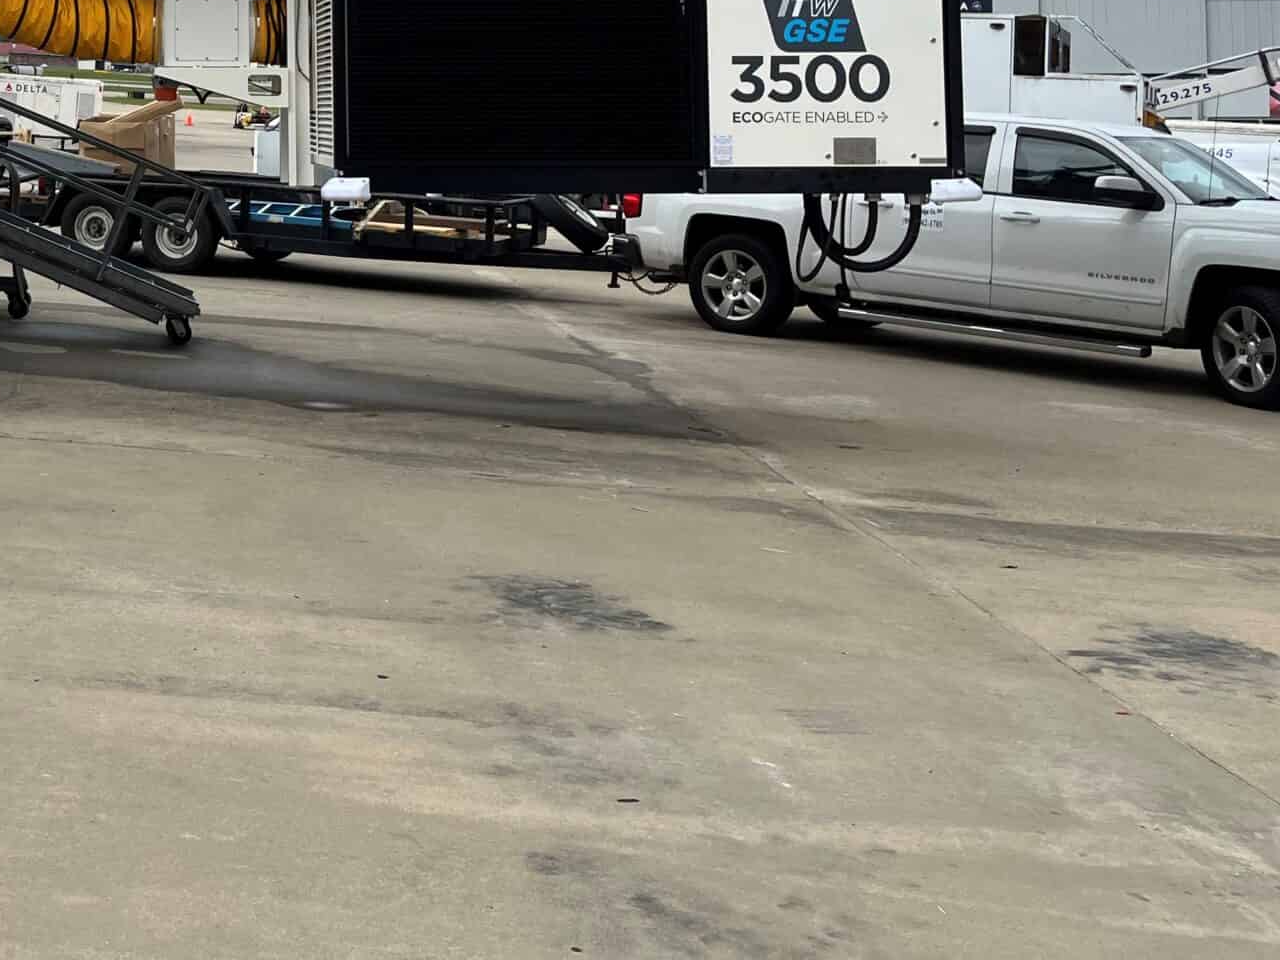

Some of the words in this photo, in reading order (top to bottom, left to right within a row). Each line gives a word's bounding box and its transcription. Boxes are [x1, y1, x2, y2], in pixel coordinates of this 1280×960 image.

[783, 18, 850, 43] GSE
[15, 83, 48, 93] DELTA
[730, 54, 891, 103] 3500
[1160, 82, 1212, 105] 29.275
[732, 111, 801, 124] ECOGATE
[805, 111, 875, 124] ENABLED
